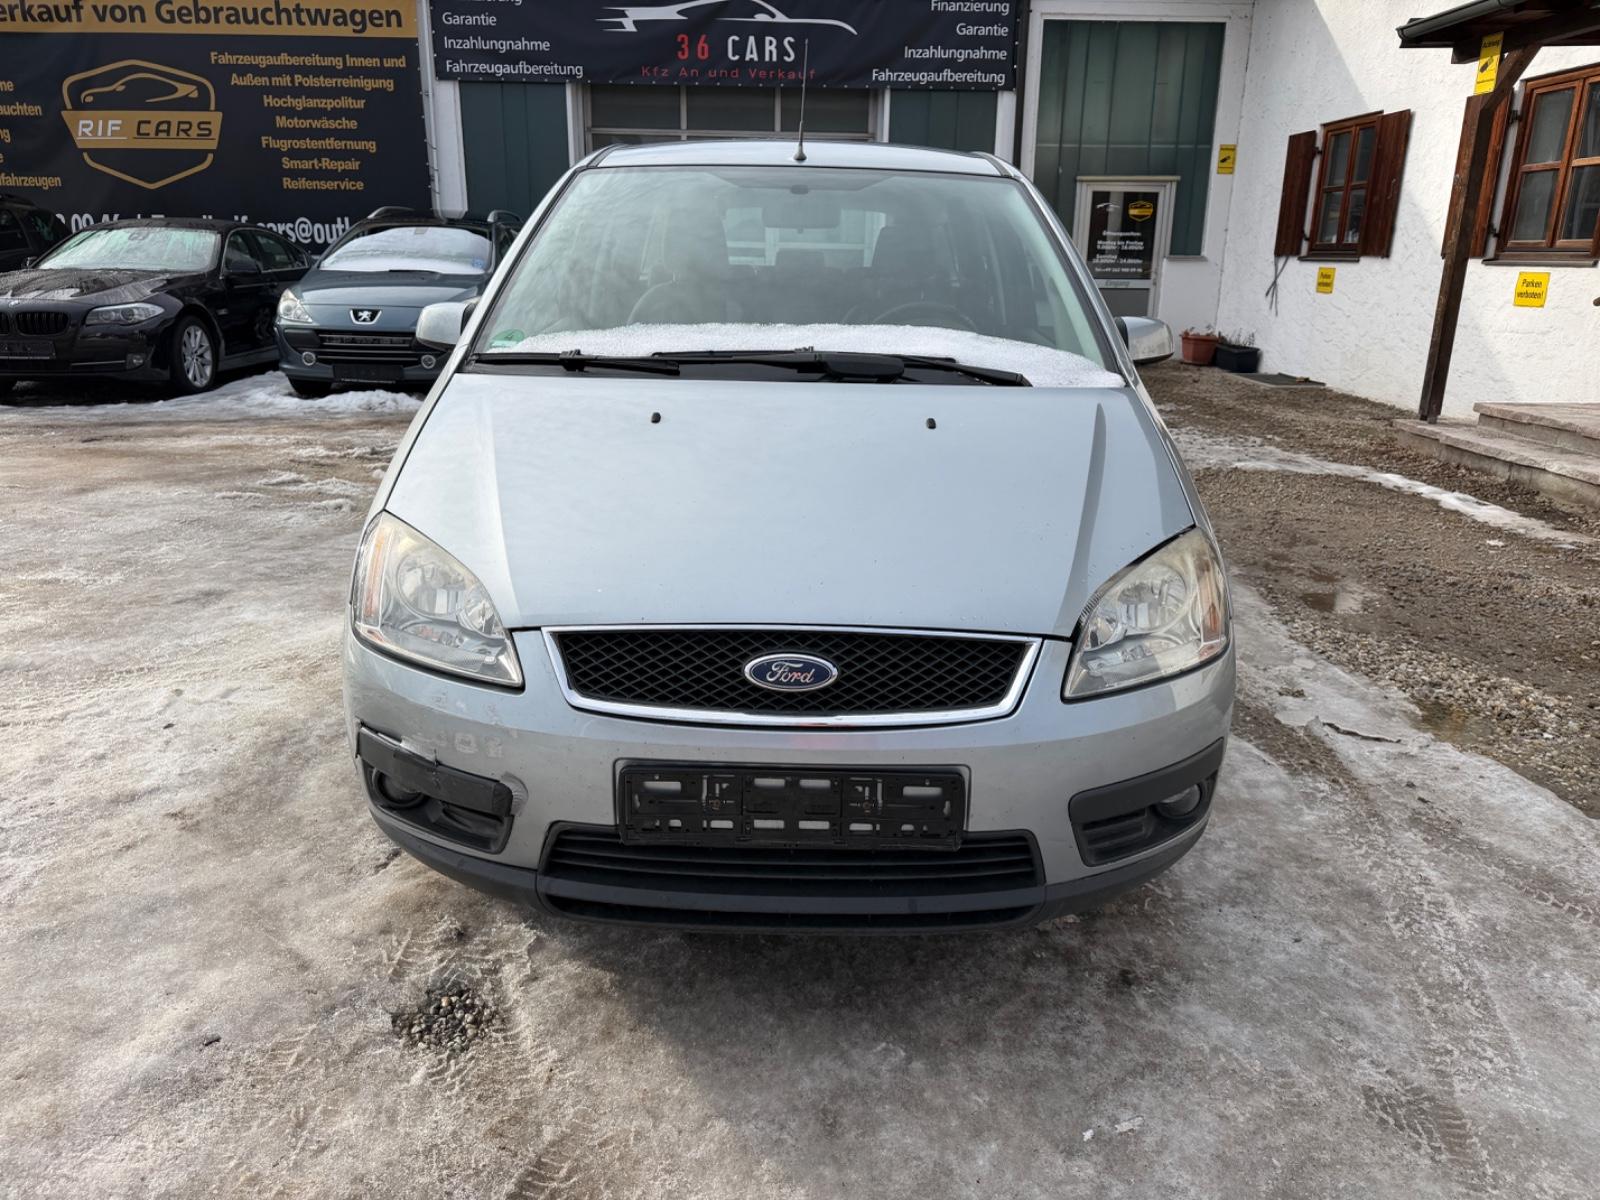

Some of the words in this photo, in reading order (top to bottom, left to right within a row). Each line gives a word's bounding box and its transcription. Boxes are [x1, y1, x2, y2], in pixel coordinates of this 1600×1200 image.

[931, 0, 1009, 15] Finanzierung
[92, 4, 146, 23] von
[155, 0, 402, 33] Gebrauchtwagen
[442, 12, 497, 26] Garantie
[956, 23, 1008, 36] Garantie
[444, 36, 550, 53] Inzahlungnahme
[727, 35, 795, 62] CARS
[210, 52, 343, 69] Fahrzeugaufbereitung
[346, 54, 380, 67] Innen
[383, 55, 406, 68] und
[904, 46, 1007, 62] Inzahlungnahme
[446, 60, 583, 78] Fahrzeugaufbereitung
[640, 66, 669, 77] Kfz
[679, 67, 699, 77] An
[708, 68, 739, 78] und
[749, 68, 816, 80] Verkauf
[872, 68, 1006, 86] Fahrzeugaufbereitung
[231, 73, 269, 87] Außen
[272, 74, 291, 87] mit
[295, 74, 394, 91] Polsterreinigung
[263, 95, 366, 110] Hochglanzpolitur
[78, 120, 122, 137] RIF
[136, 120, 212, 137] CARS
[275, 115, 358, 129] Motorwäsche
[261, 136, 377, 153] Flugrostentfernung
[281, 157, 361, 172] Smart-Repair
[282, 177, 364, 190] Reifenservice
[1522, 279, 1543, 288] Parken
[766, 661, 815, 683] Ford
